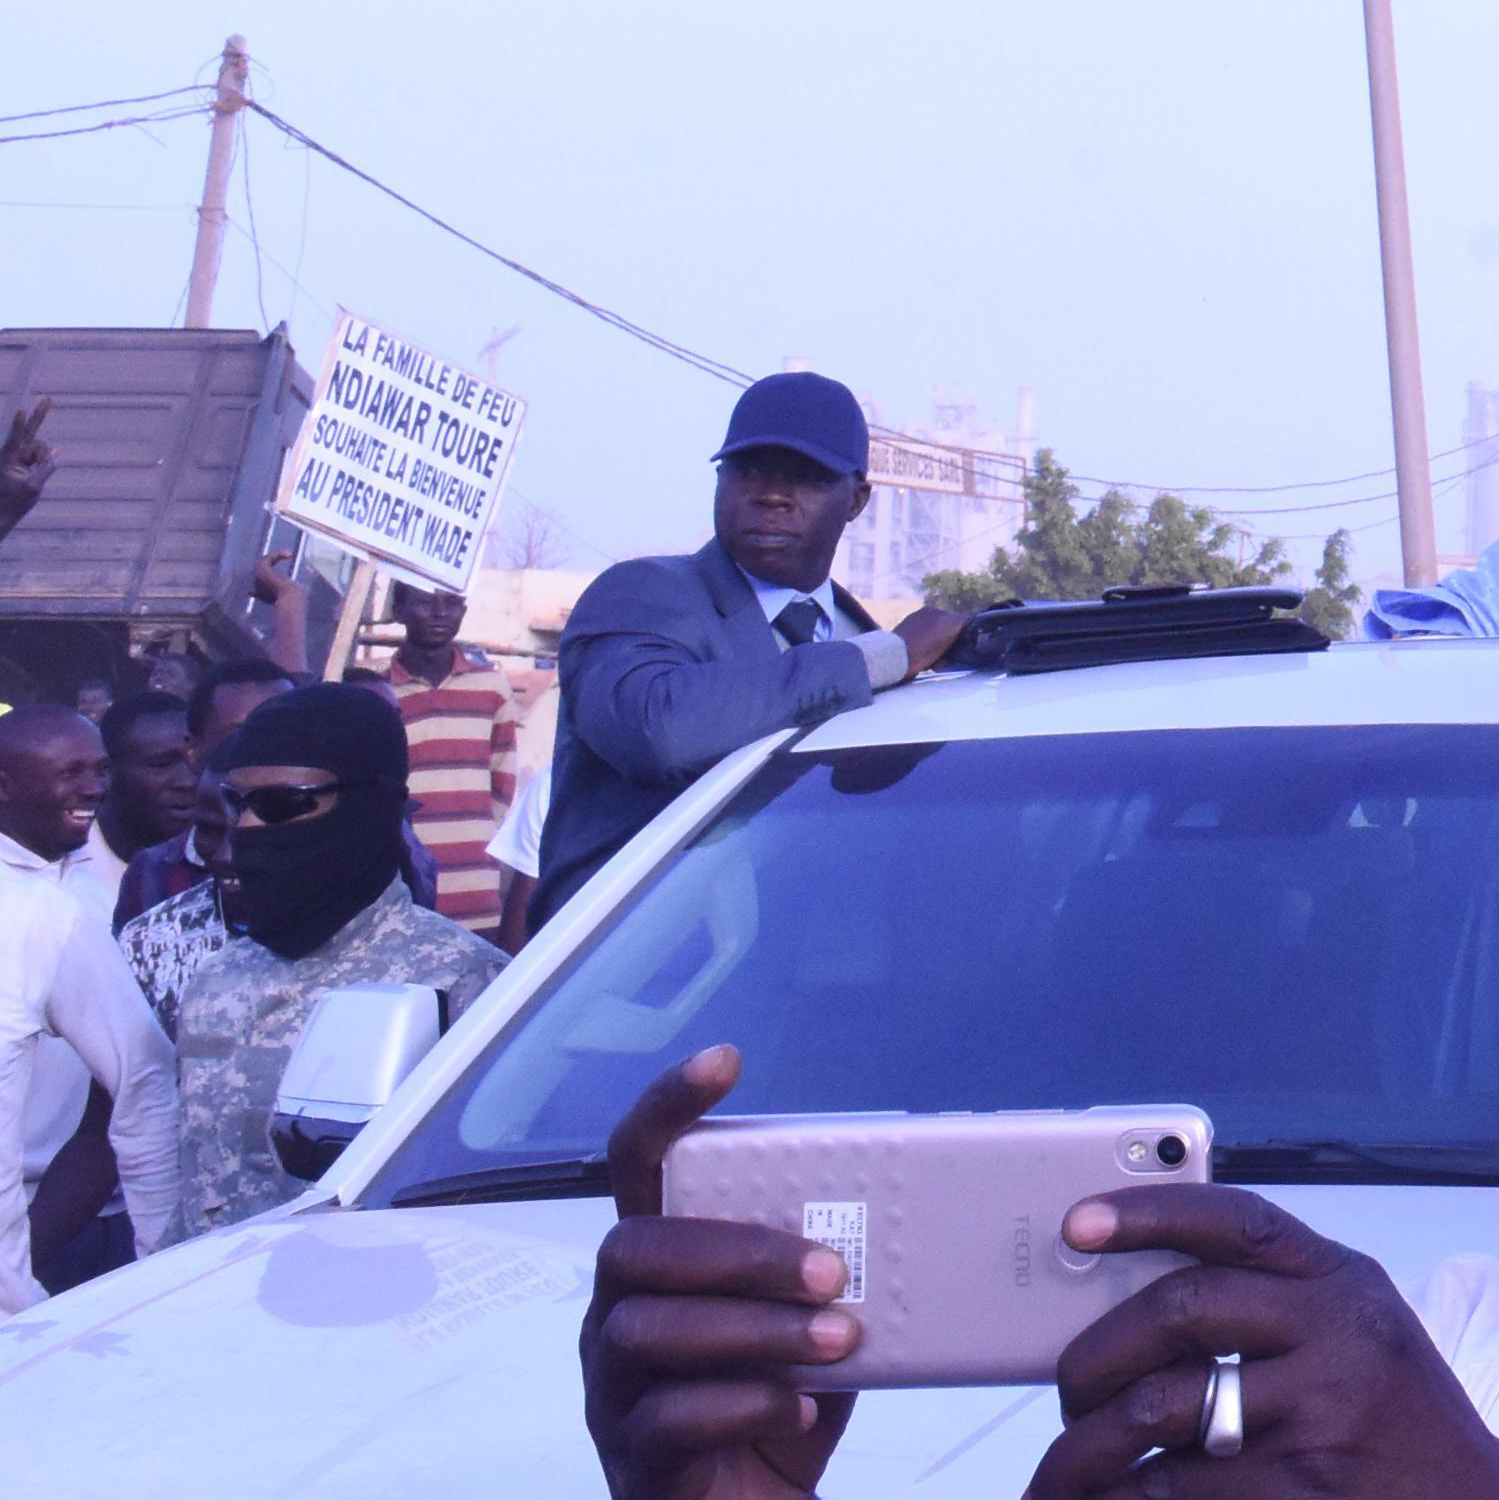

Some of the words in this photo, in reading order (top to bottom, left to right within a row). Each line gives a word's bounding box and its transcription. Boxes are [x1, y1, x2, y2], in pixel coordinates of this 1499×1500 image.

[326, 360, 433, 445] NDIAWAR
[432, 410, 503, 479] TOURE
[342, 320, 369, 357] LA
[373, 330, 450, 397] FAMILLE
[452, 374, 480, 410] DE
[477, 388, 517, 428] FEU
[295, 457, 331, 503] AU
[327, 471, 423, 547] PRESIDENT
[420, 510, 472, 570] WADE
[313, 413, 388, 474] SOUHAITE
[385, 448, 408, 484] LA
[408, 458, 487, 520] BIENVENUE
[1013, 1213, 1030, 1288] TECNO
